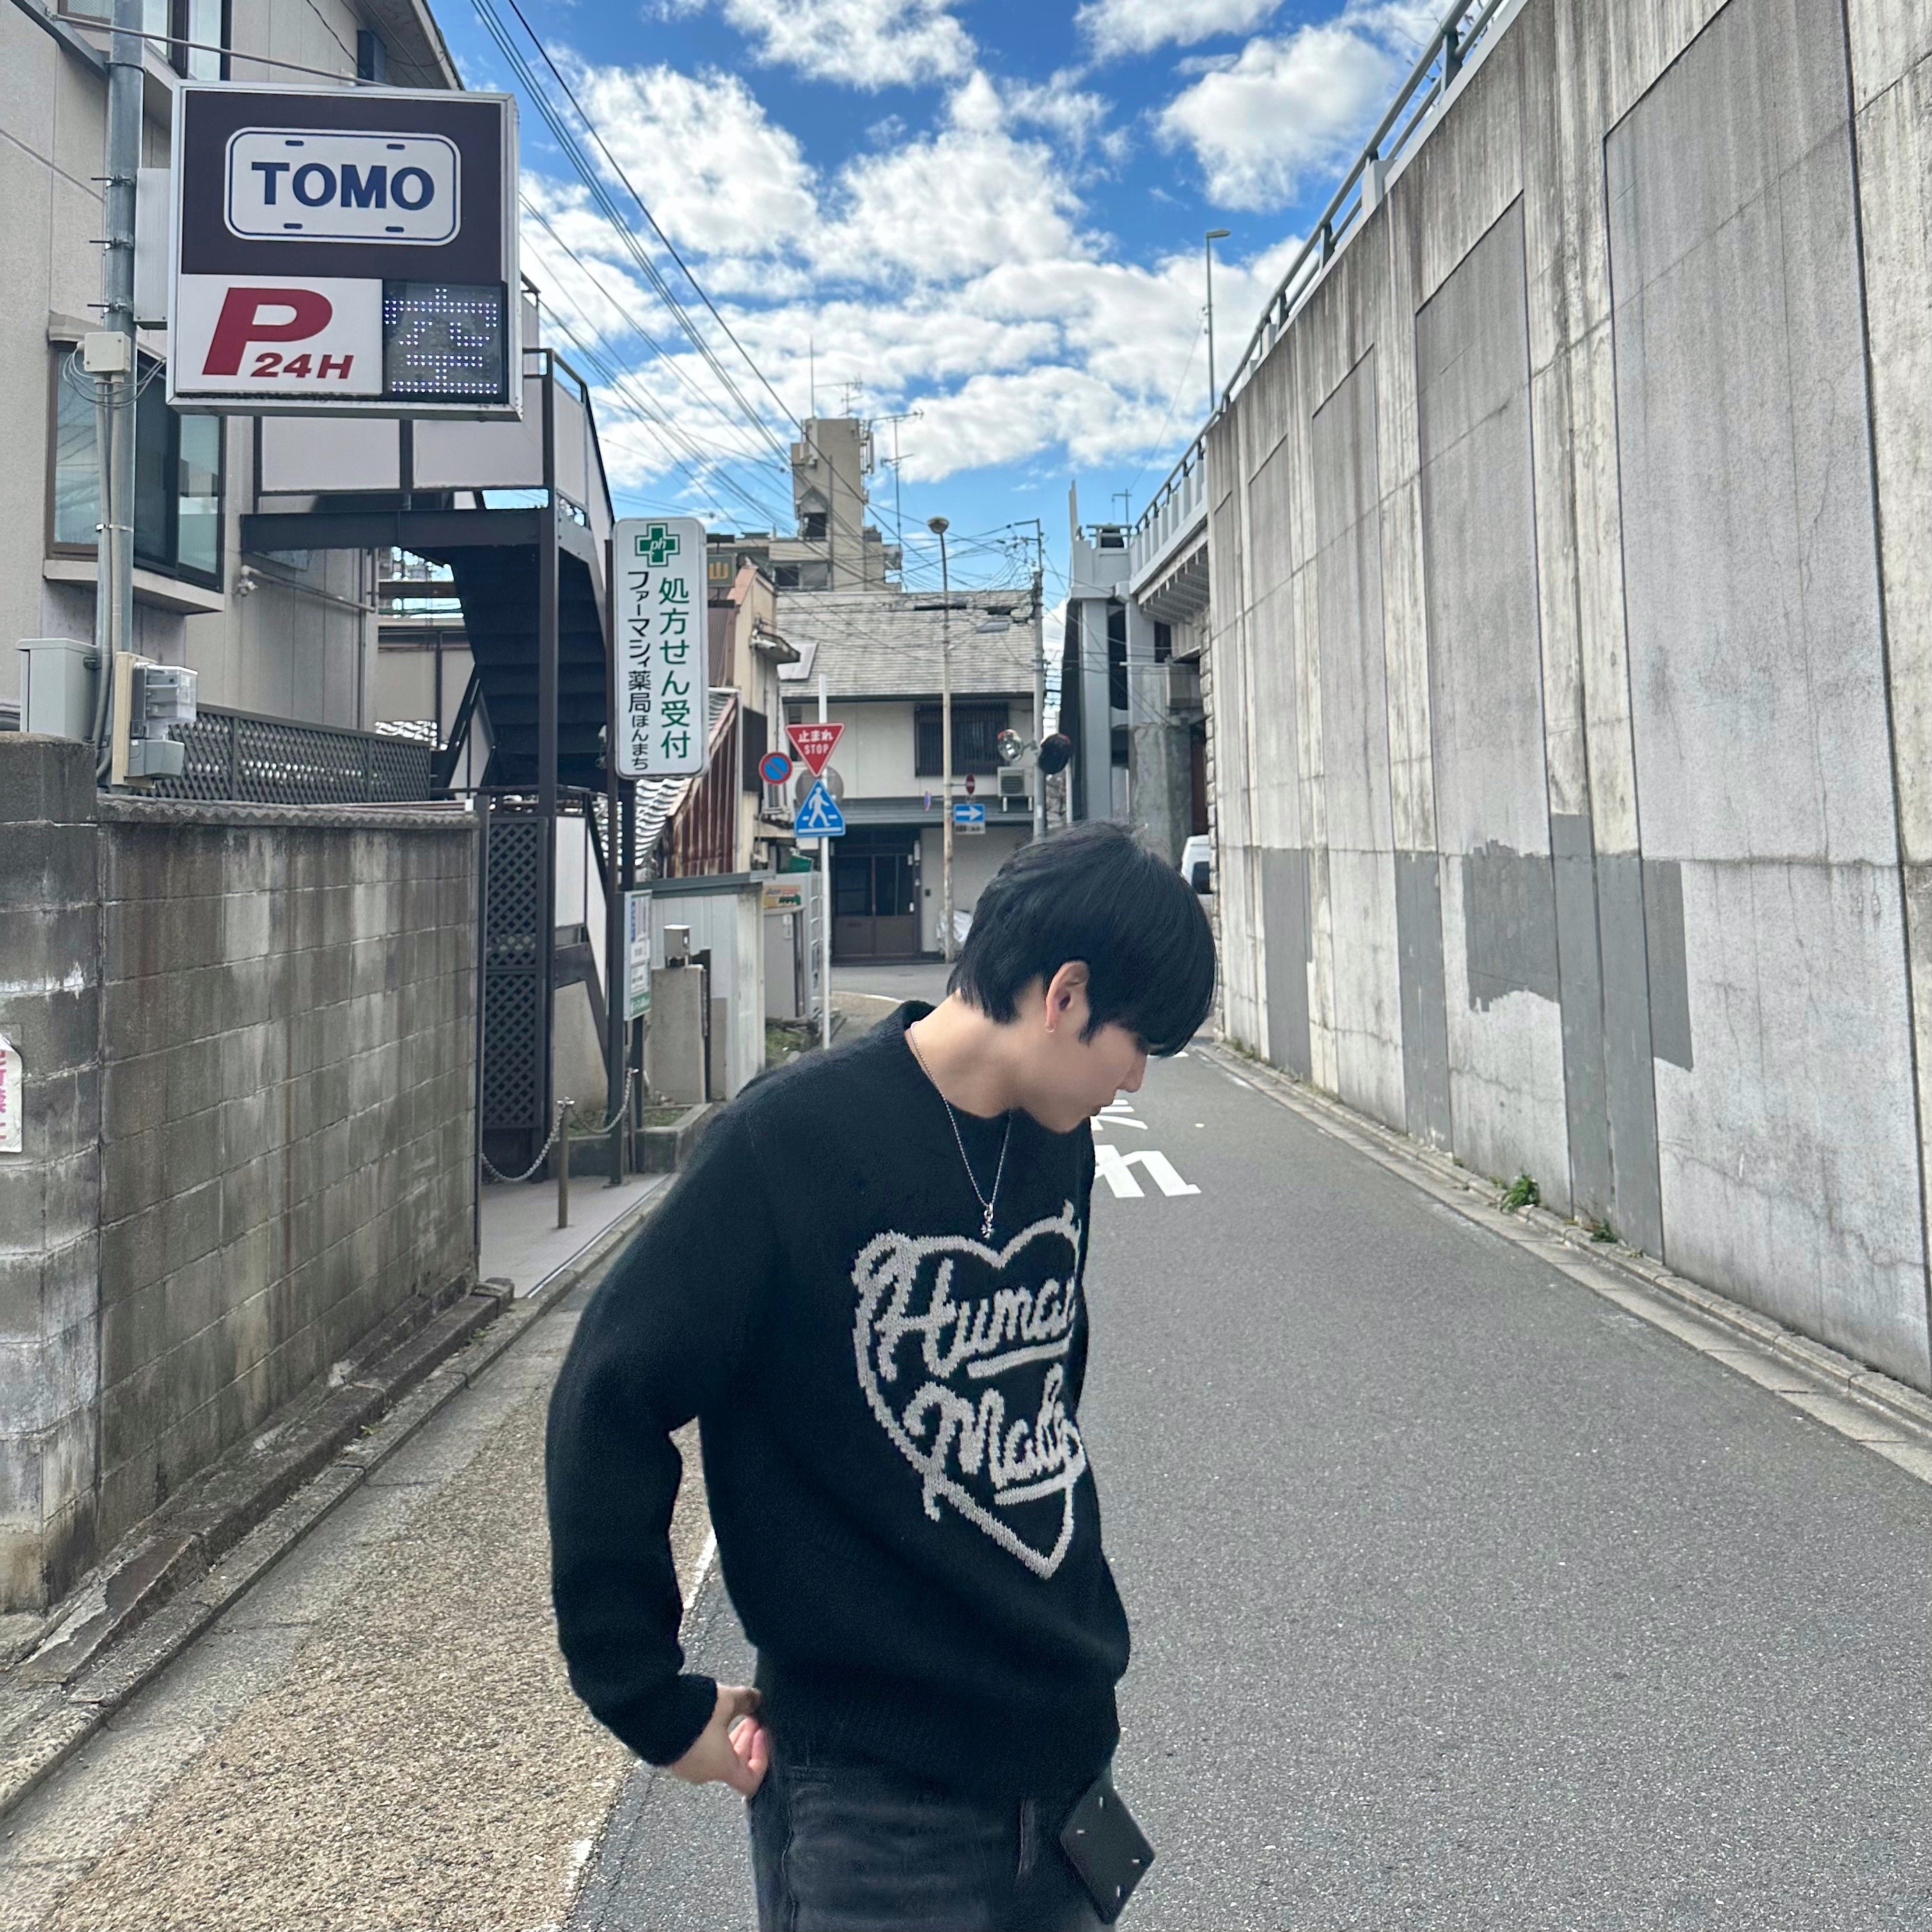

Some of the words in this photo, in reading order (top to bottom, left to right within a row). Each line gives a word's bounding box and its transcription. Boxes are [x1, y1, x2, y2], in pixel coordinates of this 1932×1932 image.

[251, 162, 435, 210] TOMO
[202, 287, 333, 376] P
[384, 288, 498, 394] 空
[250, 352, 354, 379] 24H
[650, 537, 667, 555] ph
[659, 577, 691, 759] 処方せん受付
[798, 728, 833, 743] 止まれ
[803, 743, 829, 755] STOP
